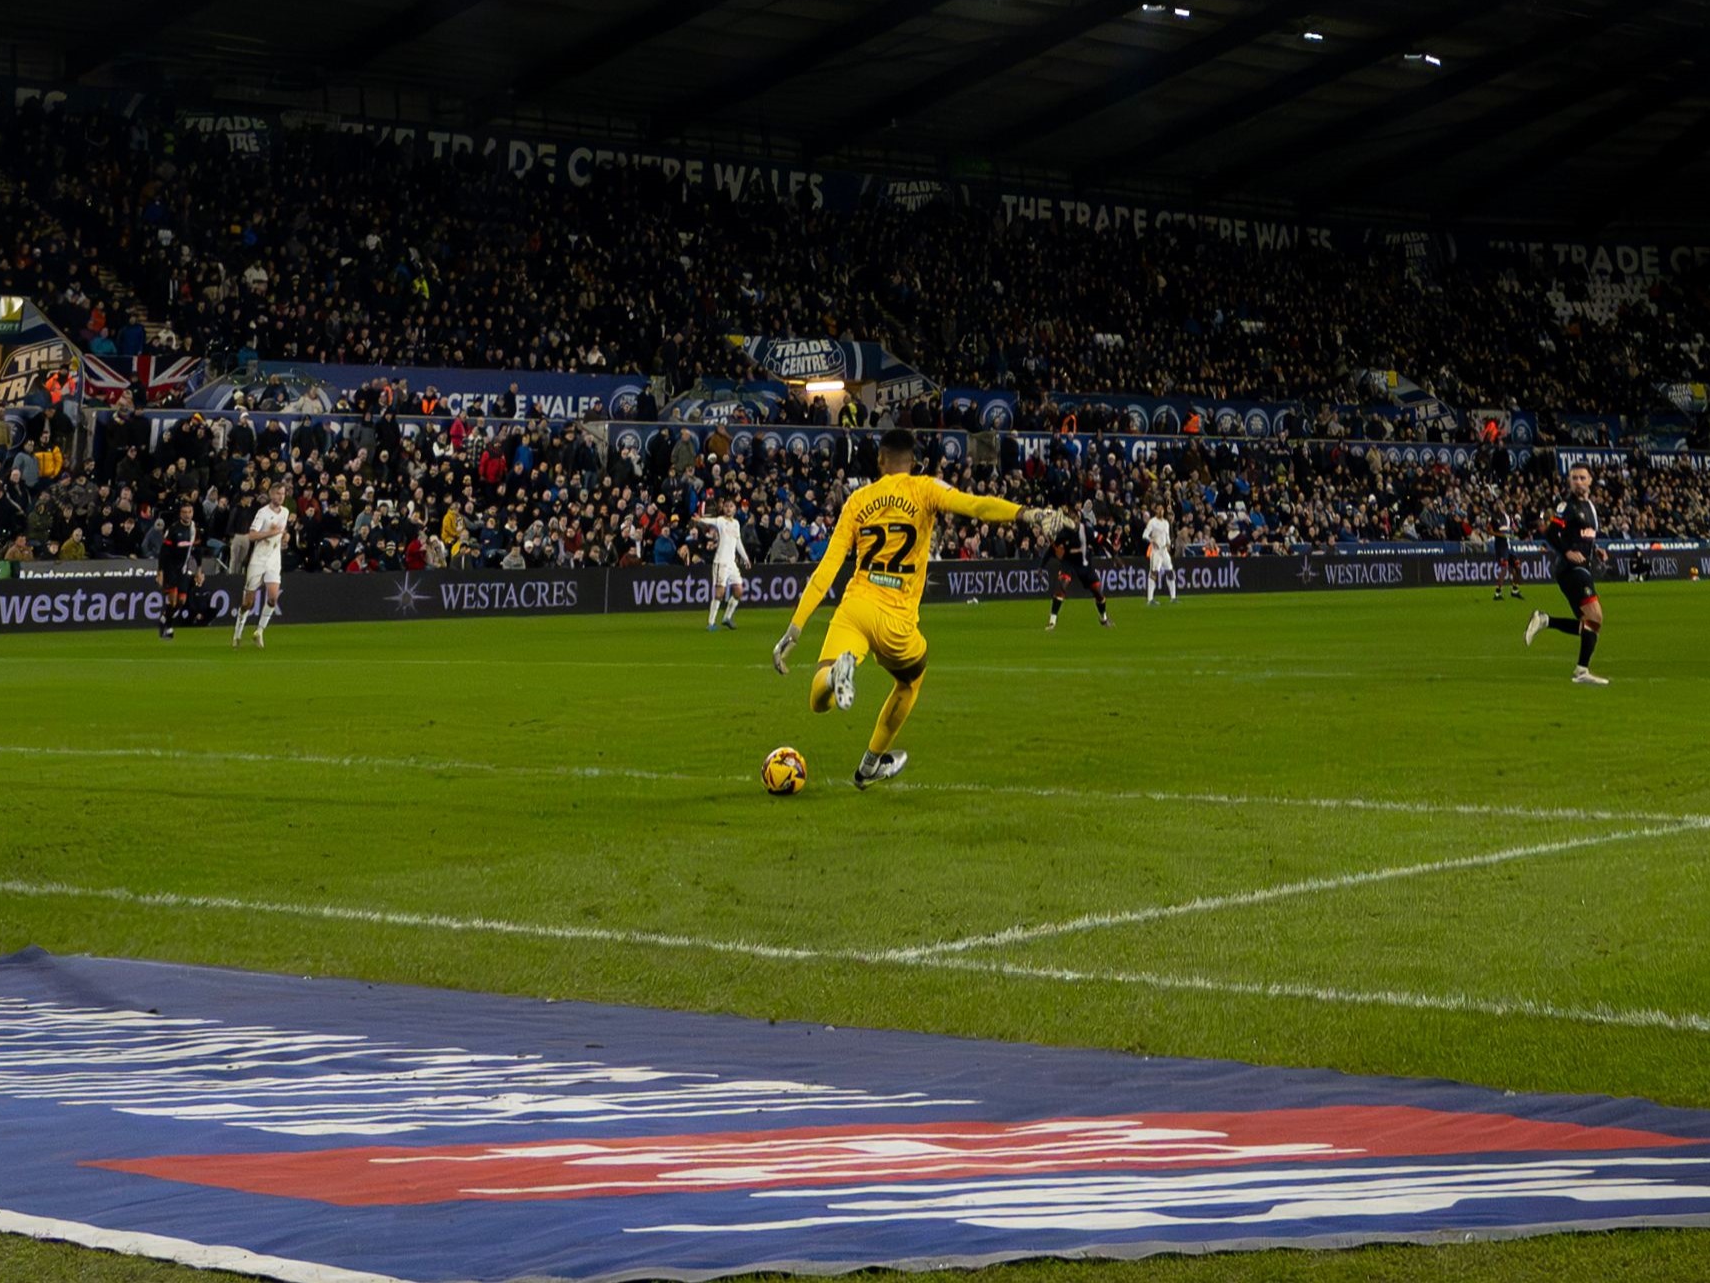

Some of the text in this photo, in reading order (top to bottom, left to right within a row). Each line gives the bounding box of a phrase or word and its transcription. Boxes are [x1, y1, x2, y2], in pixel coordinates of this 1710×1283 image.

[1554, 244, 1661, 275] TRADE
[14, 343, 64, 373] THE
[773, 337, 832, 355] TRADE
[780, 353, 829, 373] CENTRE
[449, 391, 527, 419] CENE
[876, 380, 925, 405] THE
[855, 494, 919, 525] VIGOUROUX
[859, 523, 917, 573] 22
[1093, 560, 1241, 593] westas.co.uk
[1324, 563, 1403, 585] WESTACRES
[1433, 555, 1552, 582] westacres.o.uk
[1617, 556, 1679, 577] WEACRES
[439, 580, 578, 612] WESTACRES
[631, 573, 837, 606] westaes.co.
[946, 569, 1050, 597] WESTACRES
